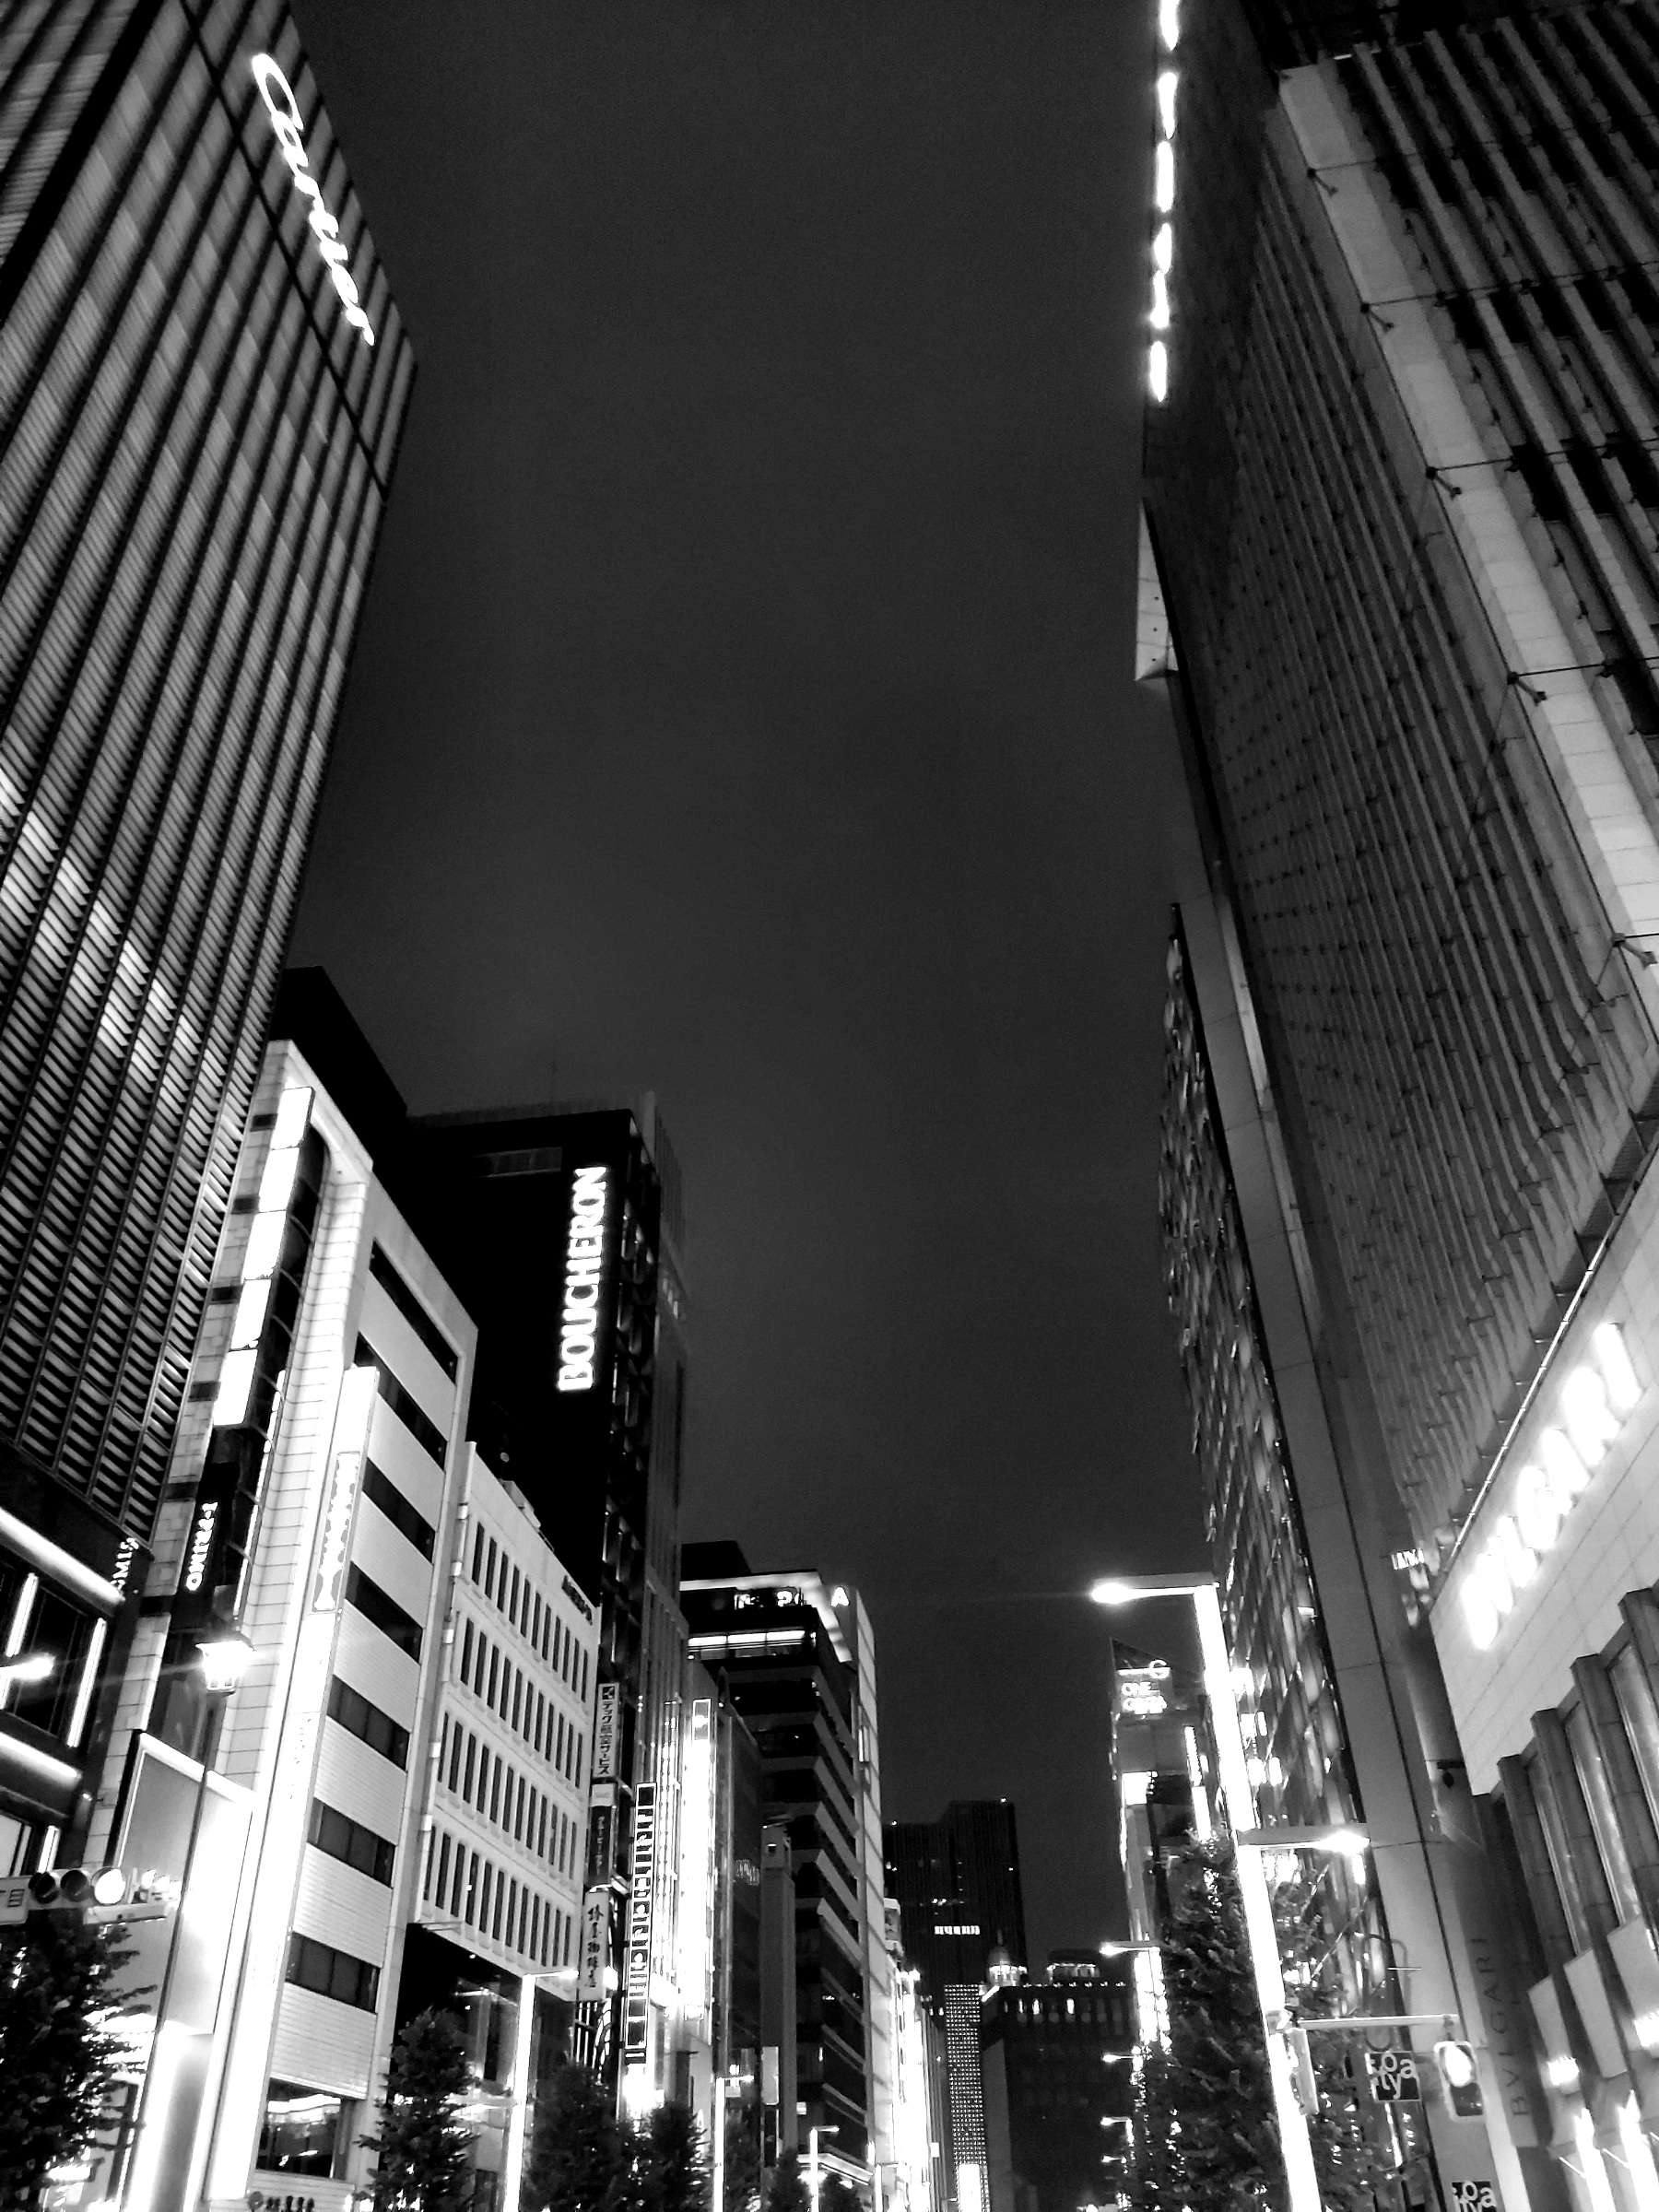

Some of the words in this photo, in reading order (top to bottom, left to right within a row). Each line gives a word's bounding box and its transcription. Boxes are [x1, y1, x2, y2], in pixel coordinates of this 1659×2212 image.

[252, 53, 375, 346] Cartier
[557, 1166, 607, 1392] BOUCHERON
[1472, 1936, 1530, 2116] BVLGARI
